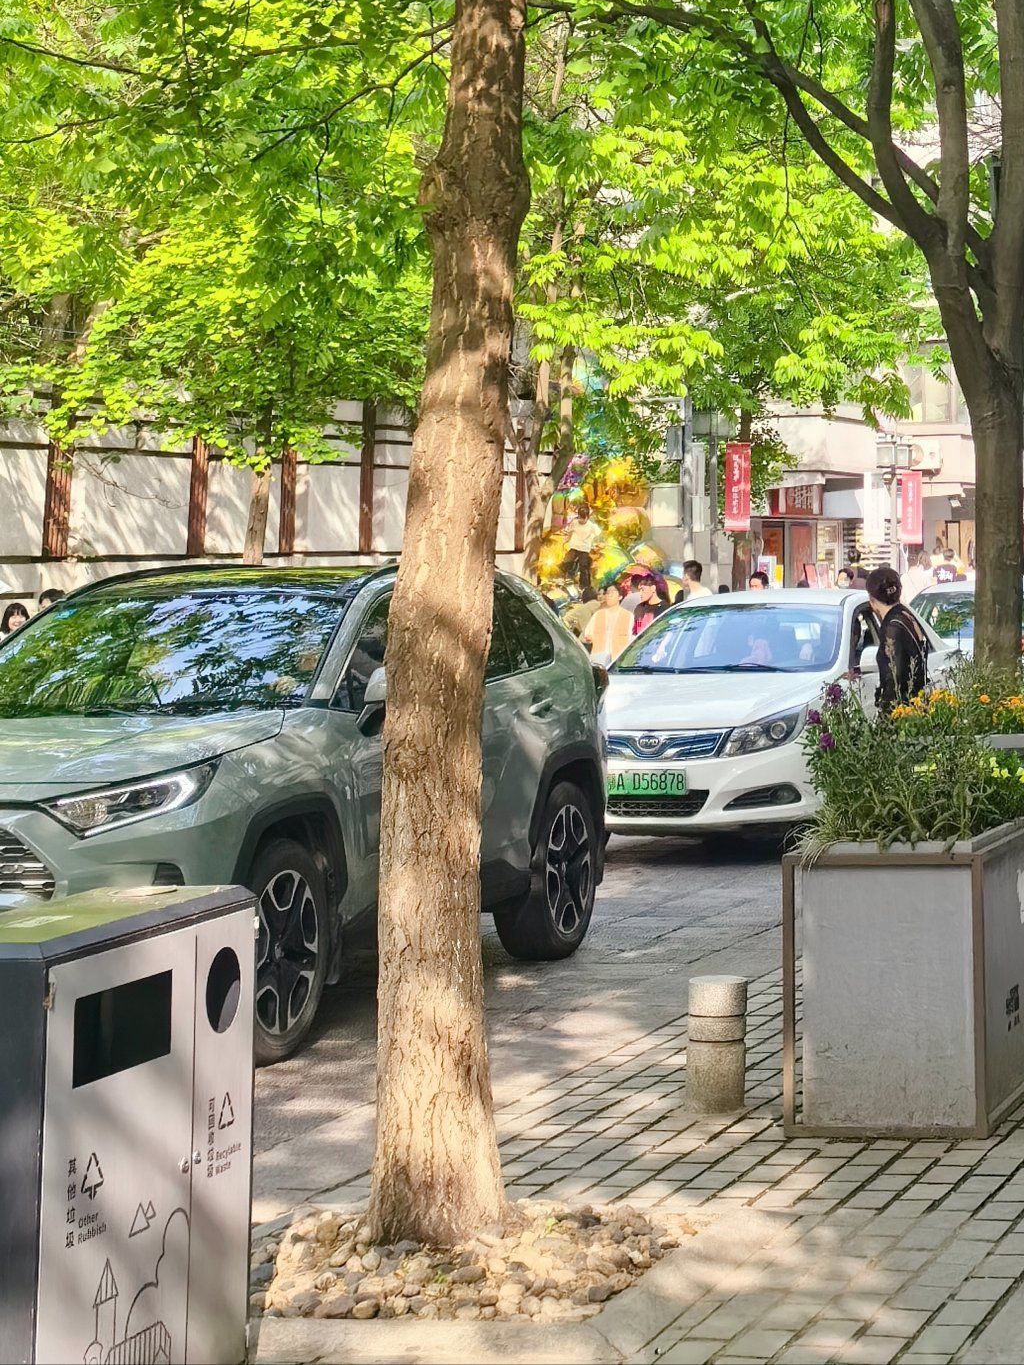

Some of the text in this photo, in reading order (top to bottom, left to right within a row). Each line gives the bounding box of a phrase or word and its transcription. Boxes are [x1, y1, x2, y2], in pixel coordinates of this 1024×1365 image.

[65, 1157, 77, 1249] 其他垃圾
[78, 1212, 98, 1229] Other
[77, 1222, 107, 1245] Rubbish
